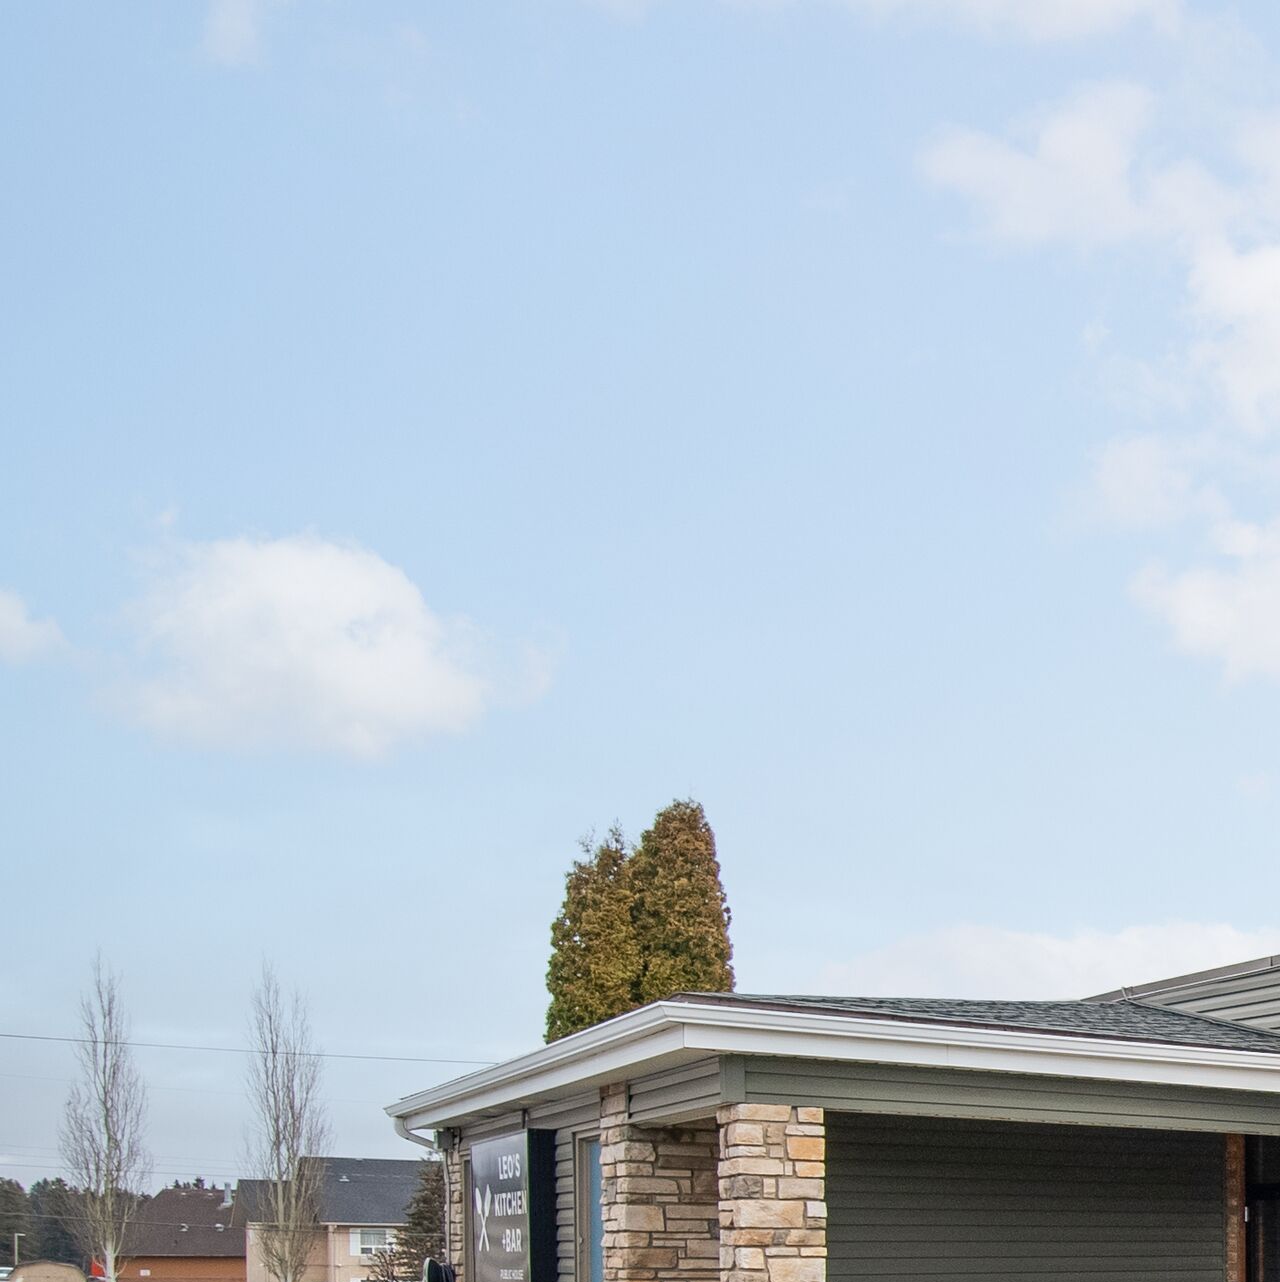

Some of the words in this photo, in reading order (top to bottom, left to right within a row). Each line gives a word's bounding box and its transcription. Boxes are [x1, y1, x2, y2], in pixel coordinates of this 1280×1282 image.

[498, 1153, 521, 1180] LEO'S
[494, 1190, 528, 1216] KITCHEN
[502, 1228, 522, 1252] +BAR
